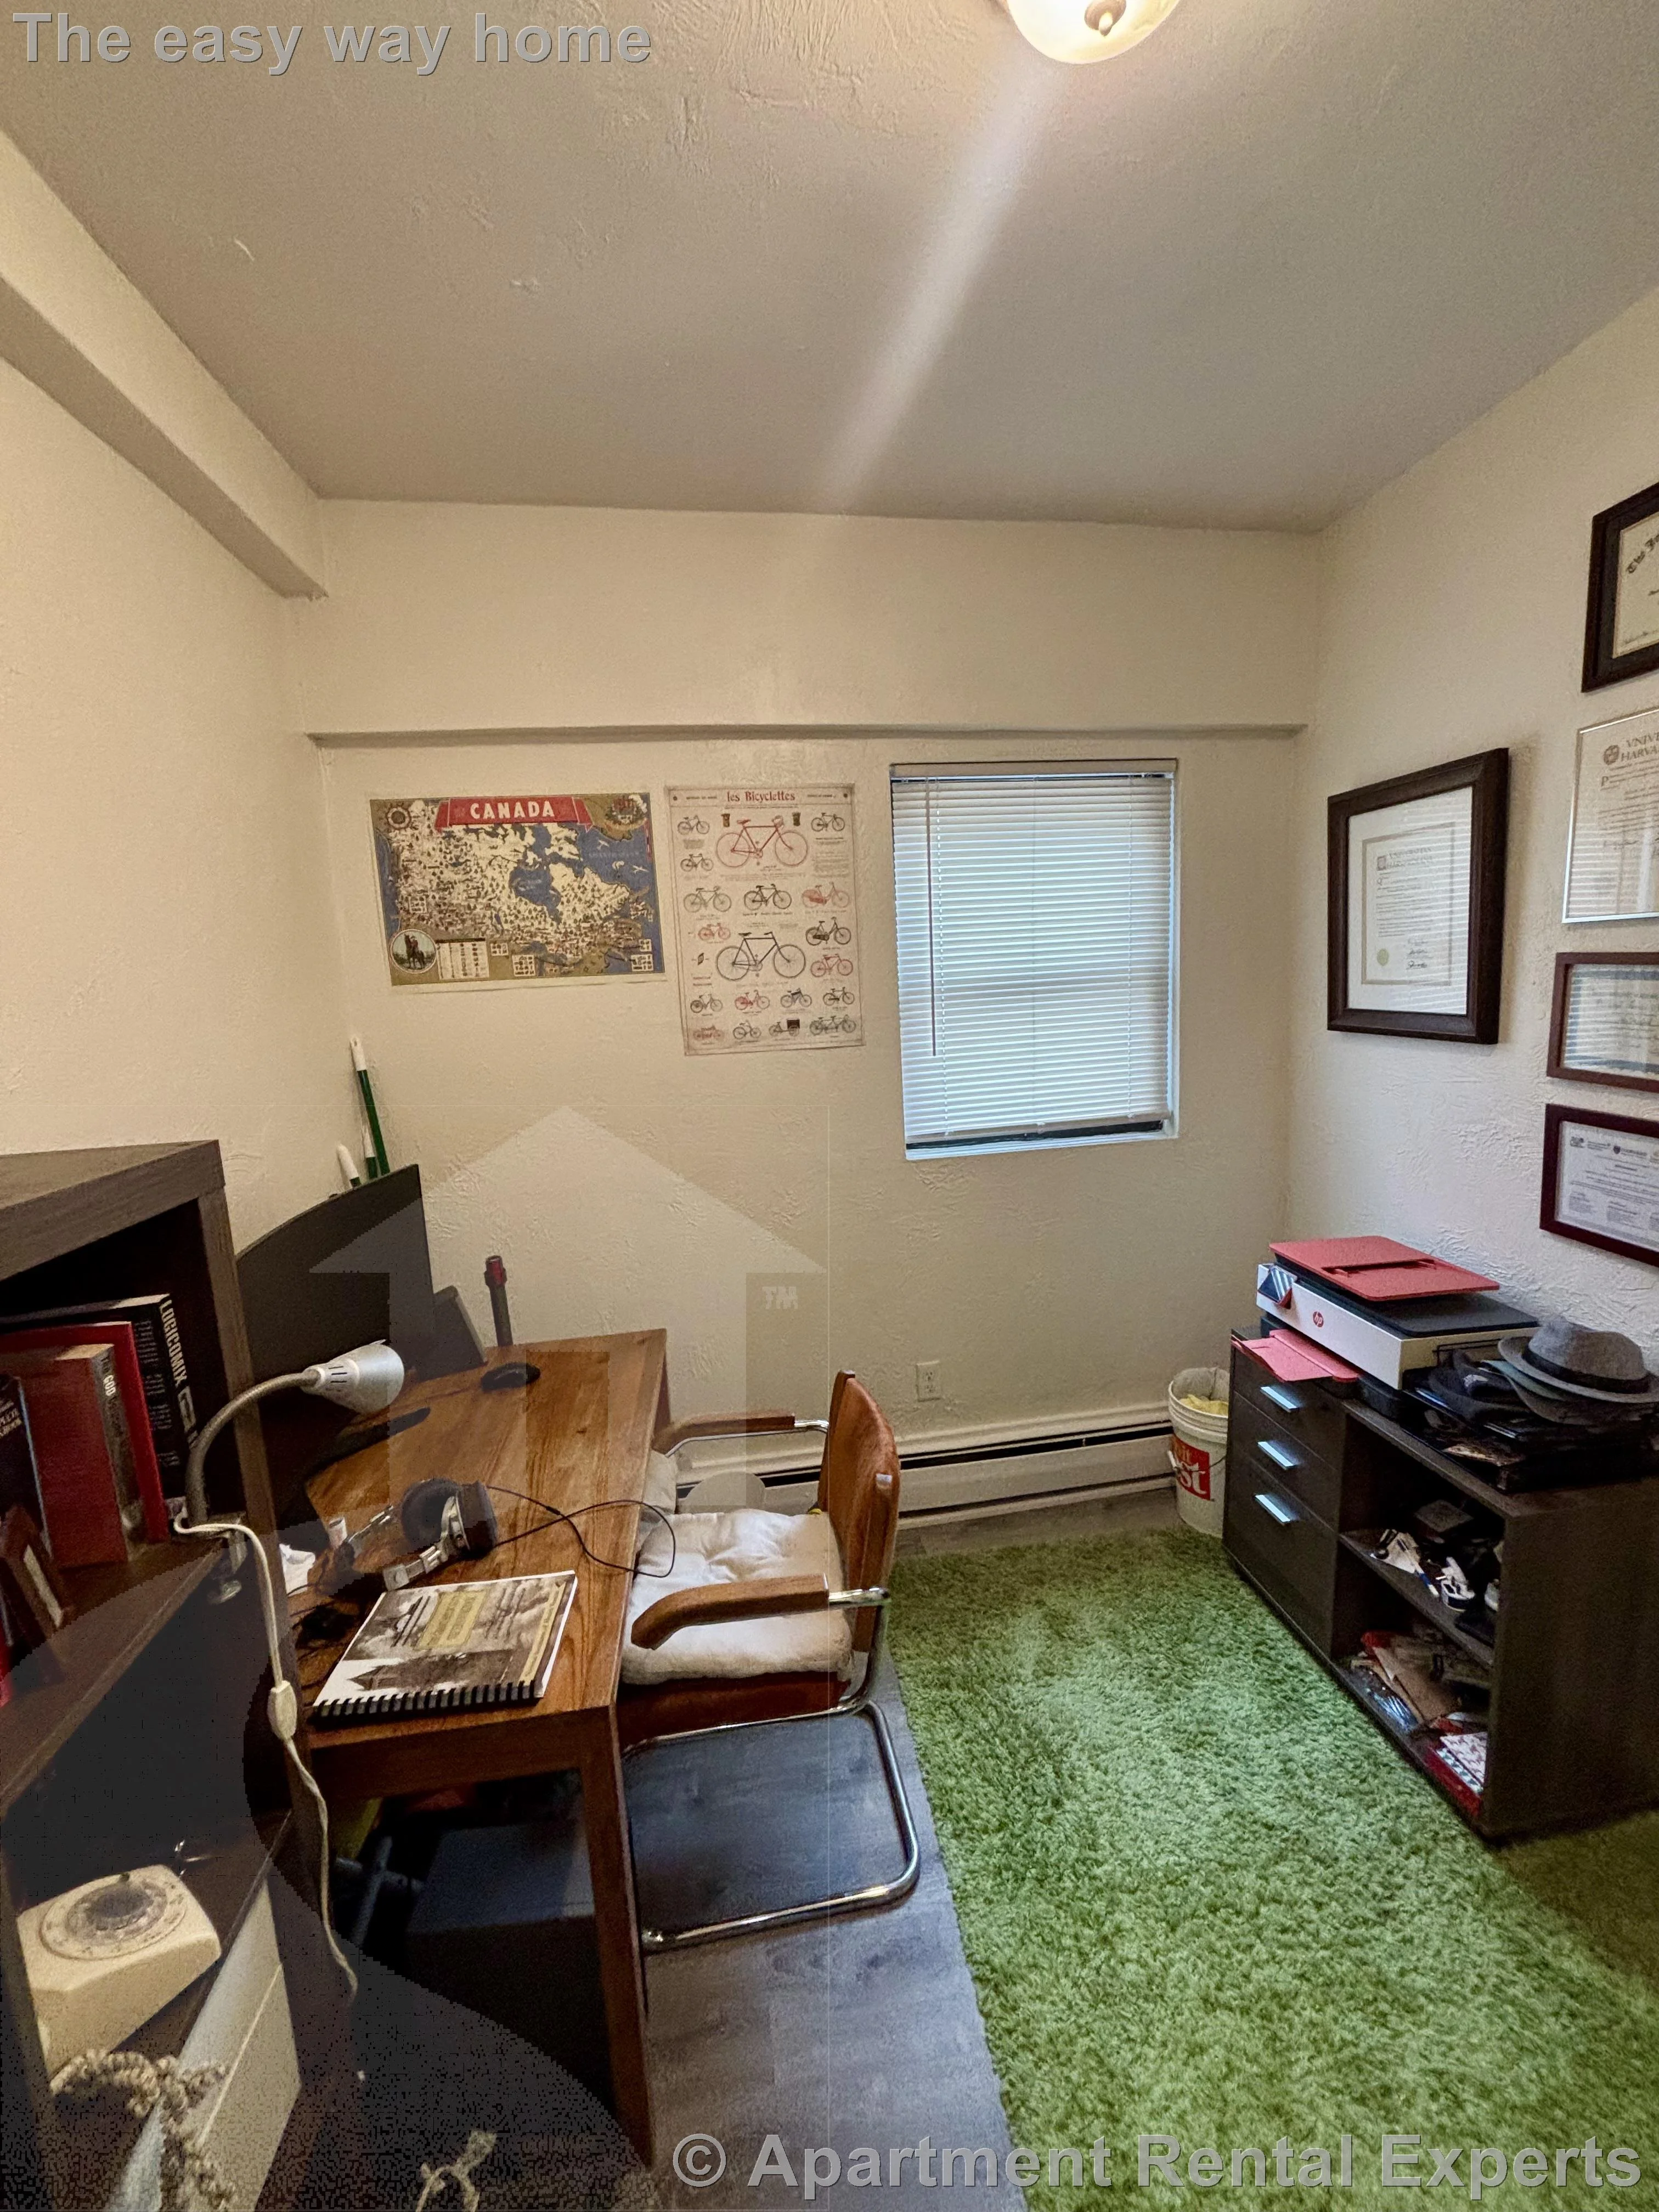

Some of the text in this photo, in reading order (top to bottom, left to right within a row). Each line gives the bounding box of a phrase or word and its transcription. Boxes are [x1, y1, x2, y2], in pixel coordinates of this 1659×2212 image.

[745, 790, 795, 804] Bicyclettes
[470, 800, 555, 820] CANADA
[159, 1299, 188, 1388] LOGICOMIX
[103, 1374, 116, 1396] GOD
